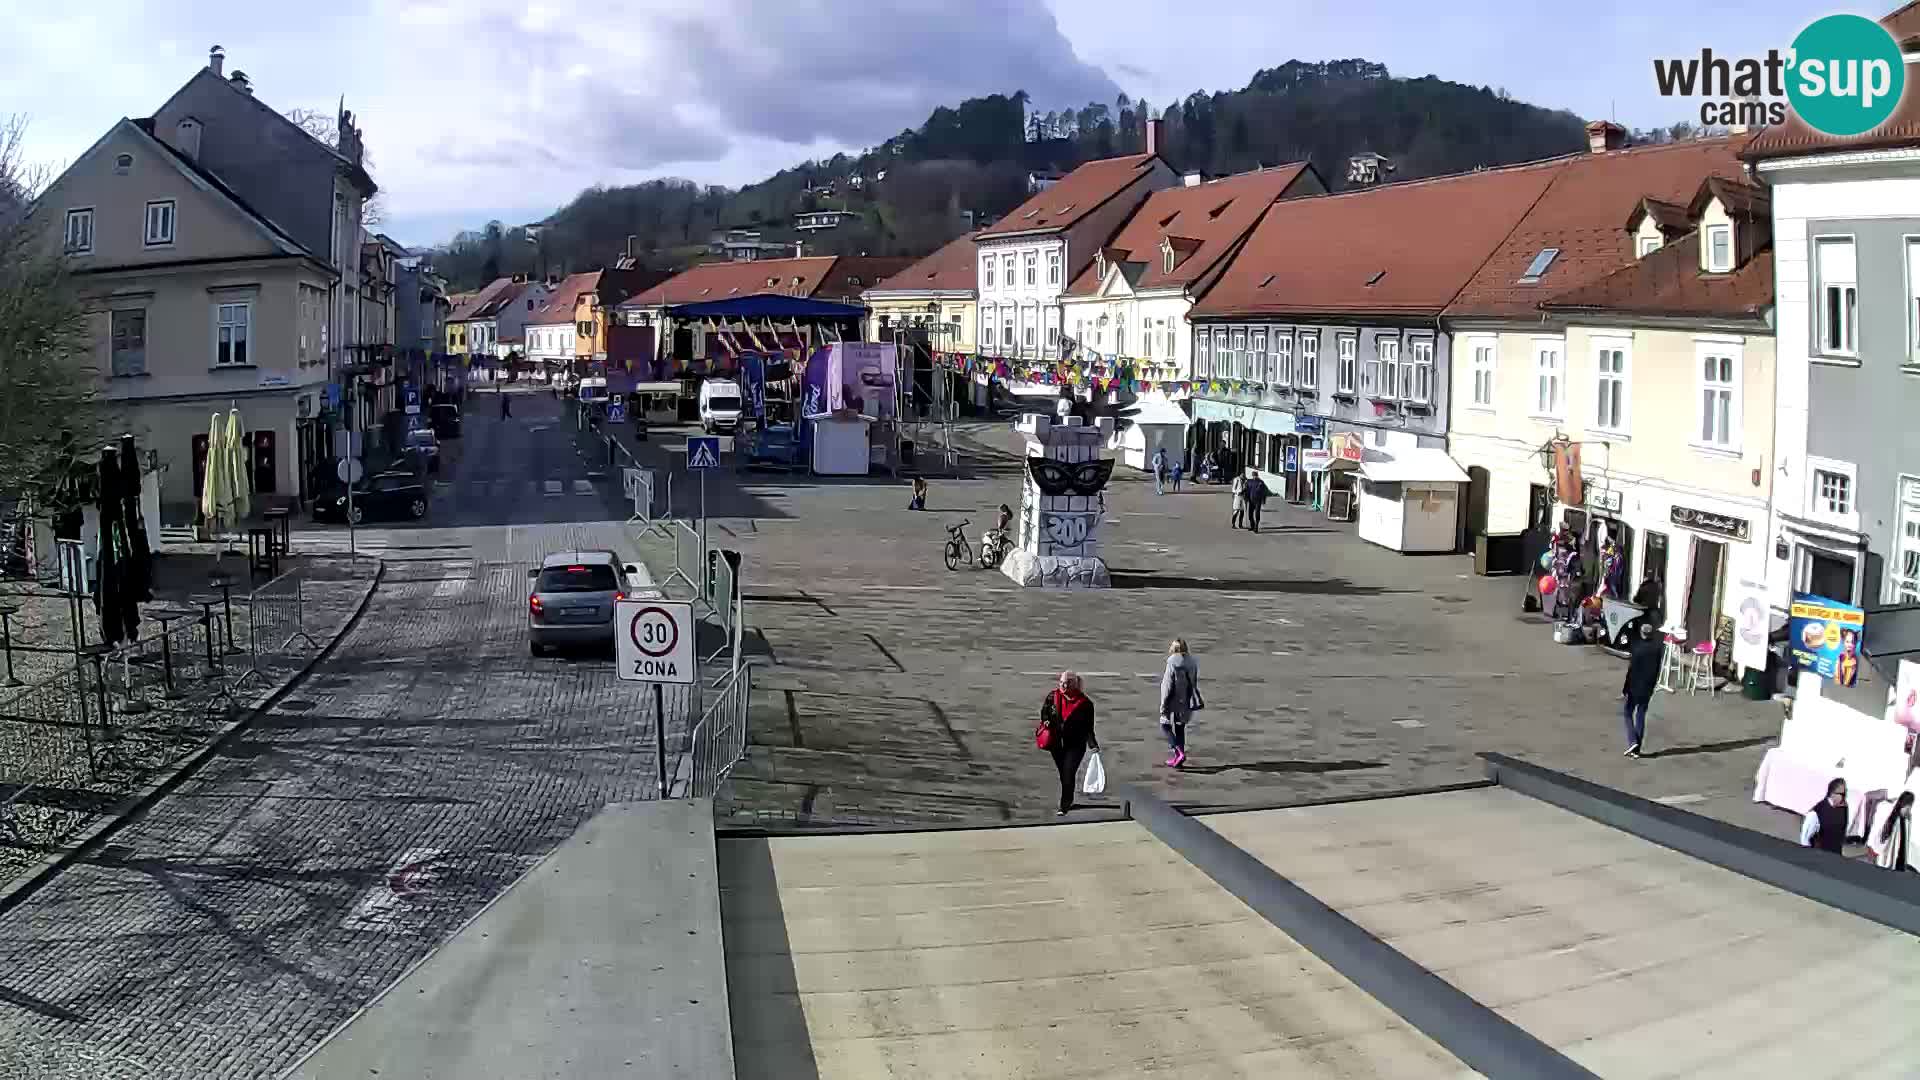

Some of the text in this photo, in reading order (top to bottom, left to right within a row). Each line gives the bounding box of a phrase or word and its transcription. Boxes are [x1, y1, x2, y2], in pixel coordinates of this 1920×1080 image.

[1047, 516, 1088, 546] 200
[643, 622, 667, 644] 30
[634, 659, 678, 677] ZONA
